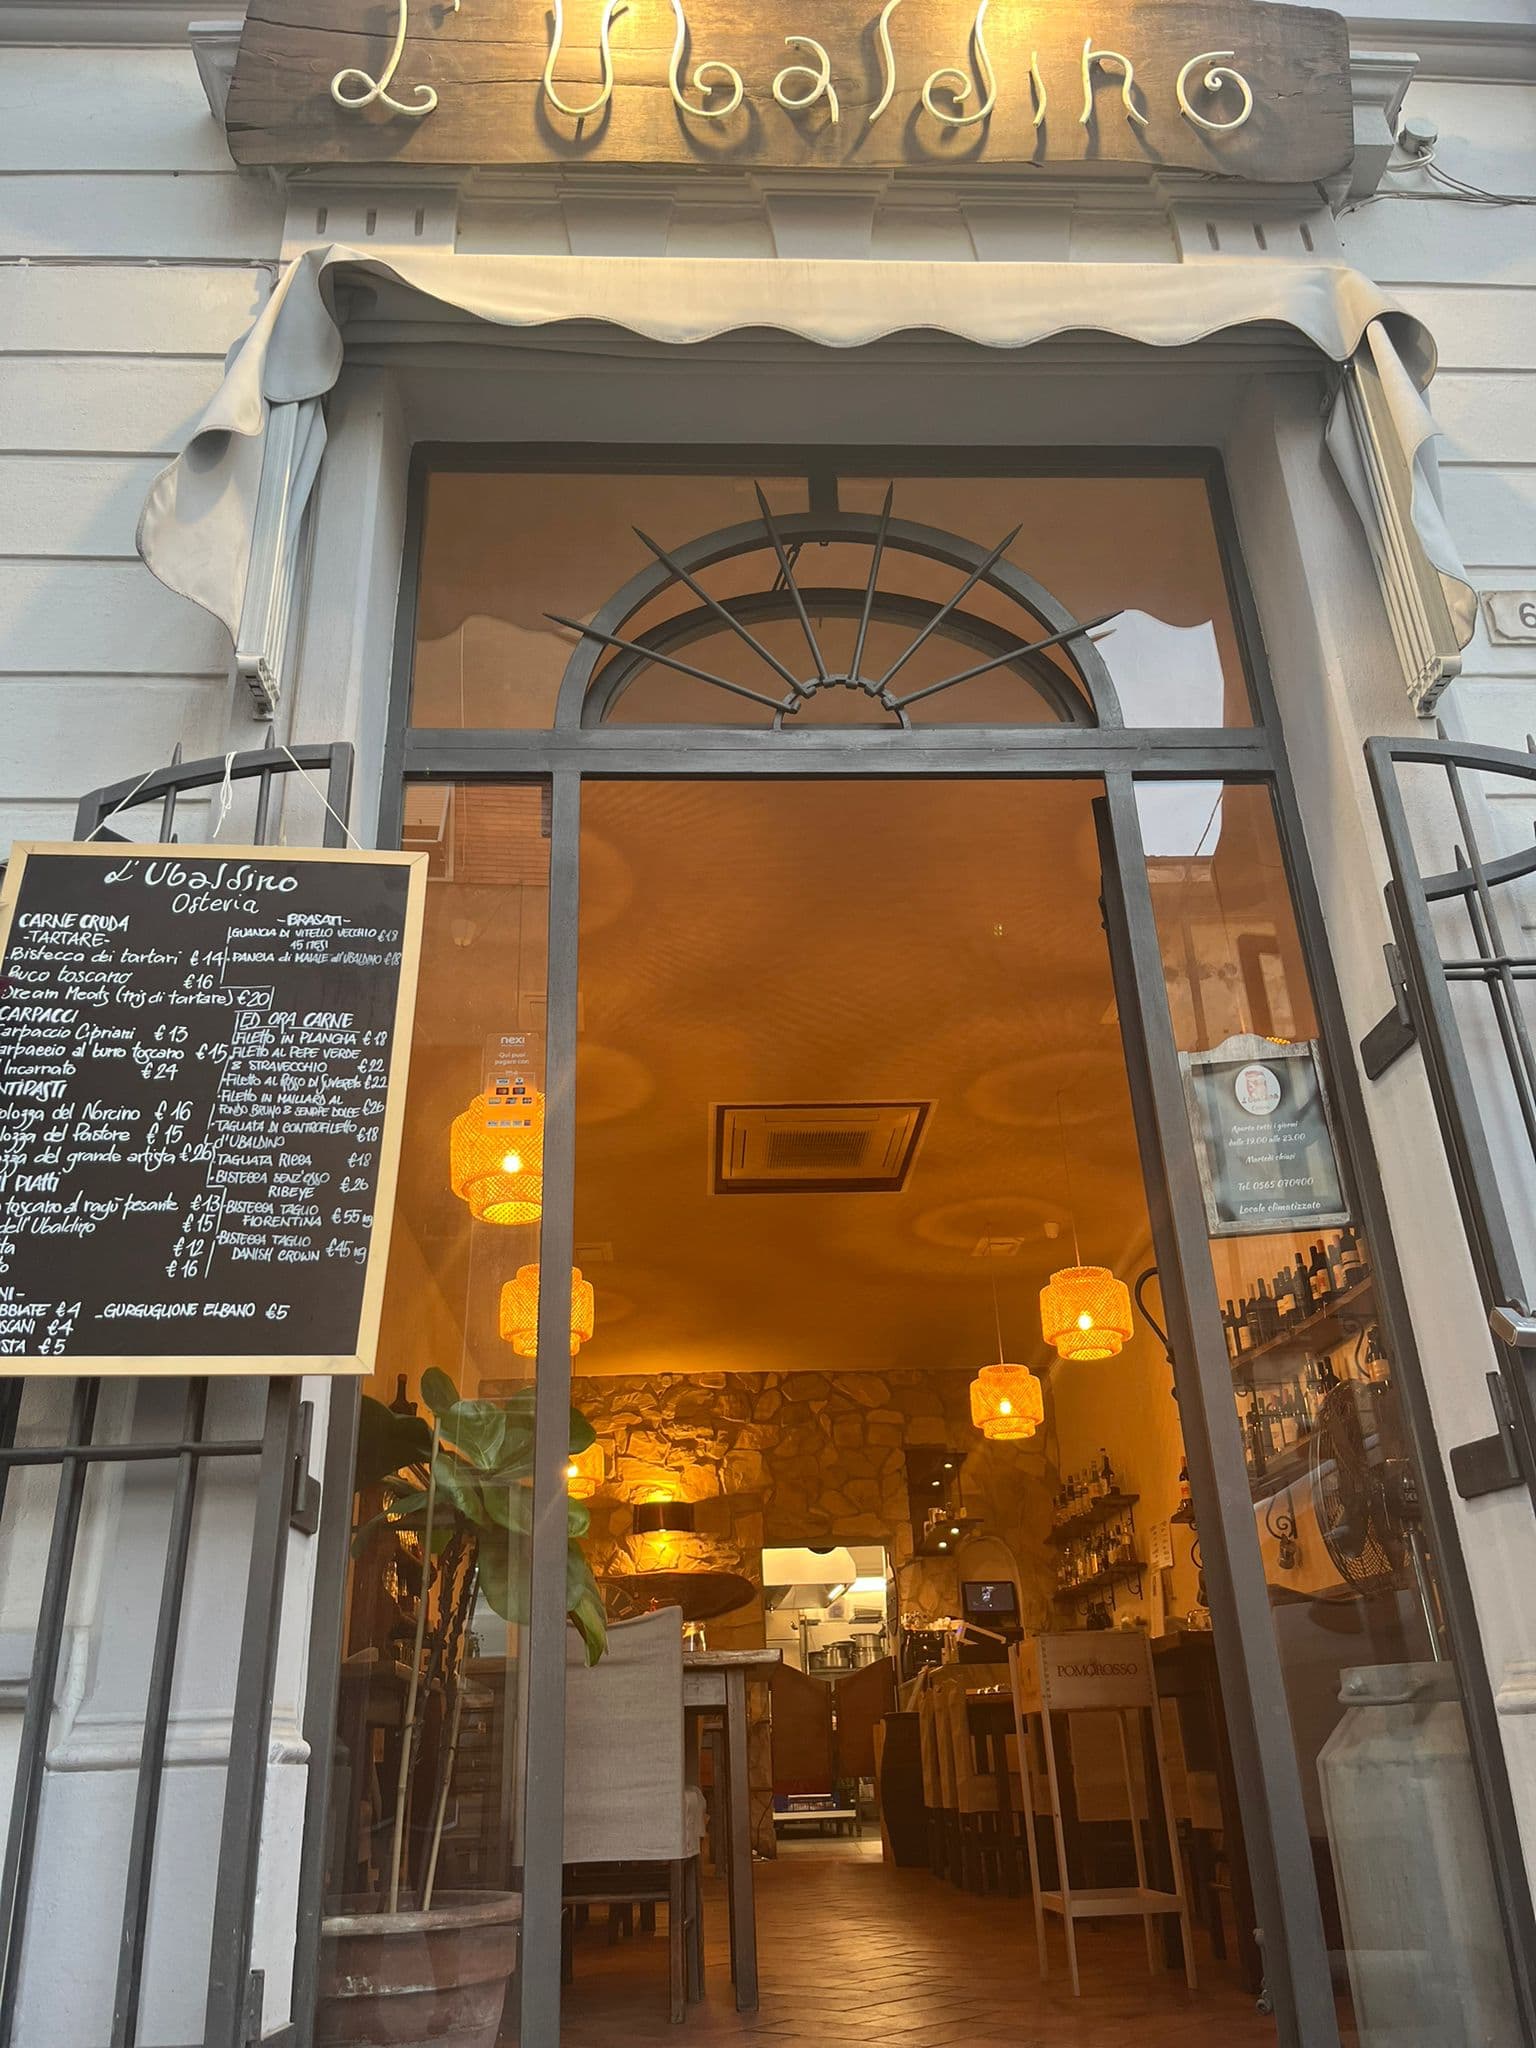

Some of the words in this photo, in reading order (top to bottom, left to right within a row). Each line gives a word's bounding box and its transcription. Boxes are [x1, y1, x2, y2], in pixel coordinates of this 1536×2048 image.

[172, 892, 260, 914] Osteria
[19, 913, 77, 929] CARNE
[79, 914, 129, 932] CRUDA
[295, 928, 334, 938] VITELLO
[337, 928, 377, 938] VECCHIO
[91, 950, 115, 963] dei
[120, 948, 182, 965] tartari
[57, 965, 133, 984] toscano
[65, 984, 110, 1007] Meats
[148, 992, 166, 1004] di
[303, 1012, 354, 1029] CARNE
[0, 1023, 72, 1042] arpaccio
[500, 1036, 526, 1044] nexi
[0, 1043, 66, 1060] arpaccio
[71, 1041, 87, 1058] al
[132, 1041, 185, 1064] toscano
[271, 1047, 286, 1058] AL
[289, 1046, 320, 1058] PEPE
[323, 1048, 362, 1059] VERDE
[264, 1076, 278, 1086] AL
[0, 1079, 68, 1102] NTIPASTI
[328, 1095, 343, 1105] AL
[52, 1102, 76, 1120] del
[82, 1099, 141, 1120] Norcino
[43, 1123, 69, 1142] del
[73, 1122, 130, 1142] Pastore
[33, 1145, 62, 1163] del
[62, 1144, 122, 1174] grande
[0, 1303, 52, 1317] BBIATE
[0, 1318, 36, 1334] SCANI
[0, 1339, 26, 1354] STA
